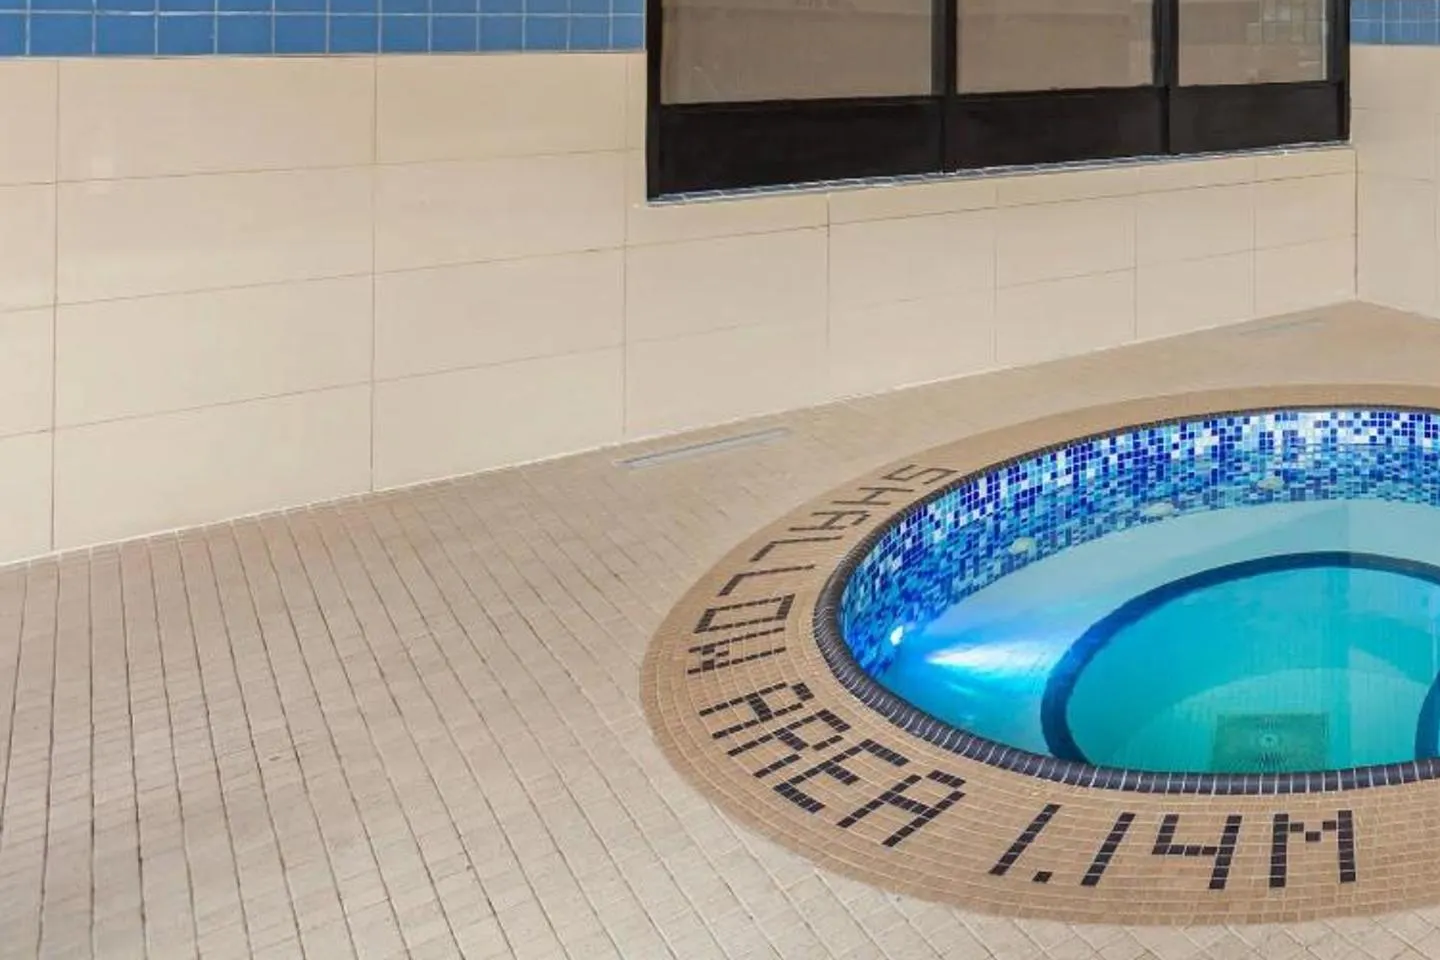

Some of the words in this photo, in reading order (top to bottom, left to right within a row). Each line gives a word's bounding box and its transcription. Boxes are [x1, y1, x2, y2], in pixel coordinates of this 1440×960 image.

[687, 463, 958, 675] SHALLOW
[698, 682, 966, 848] AREA
[989, 803, 1357, 890] 1.14M
